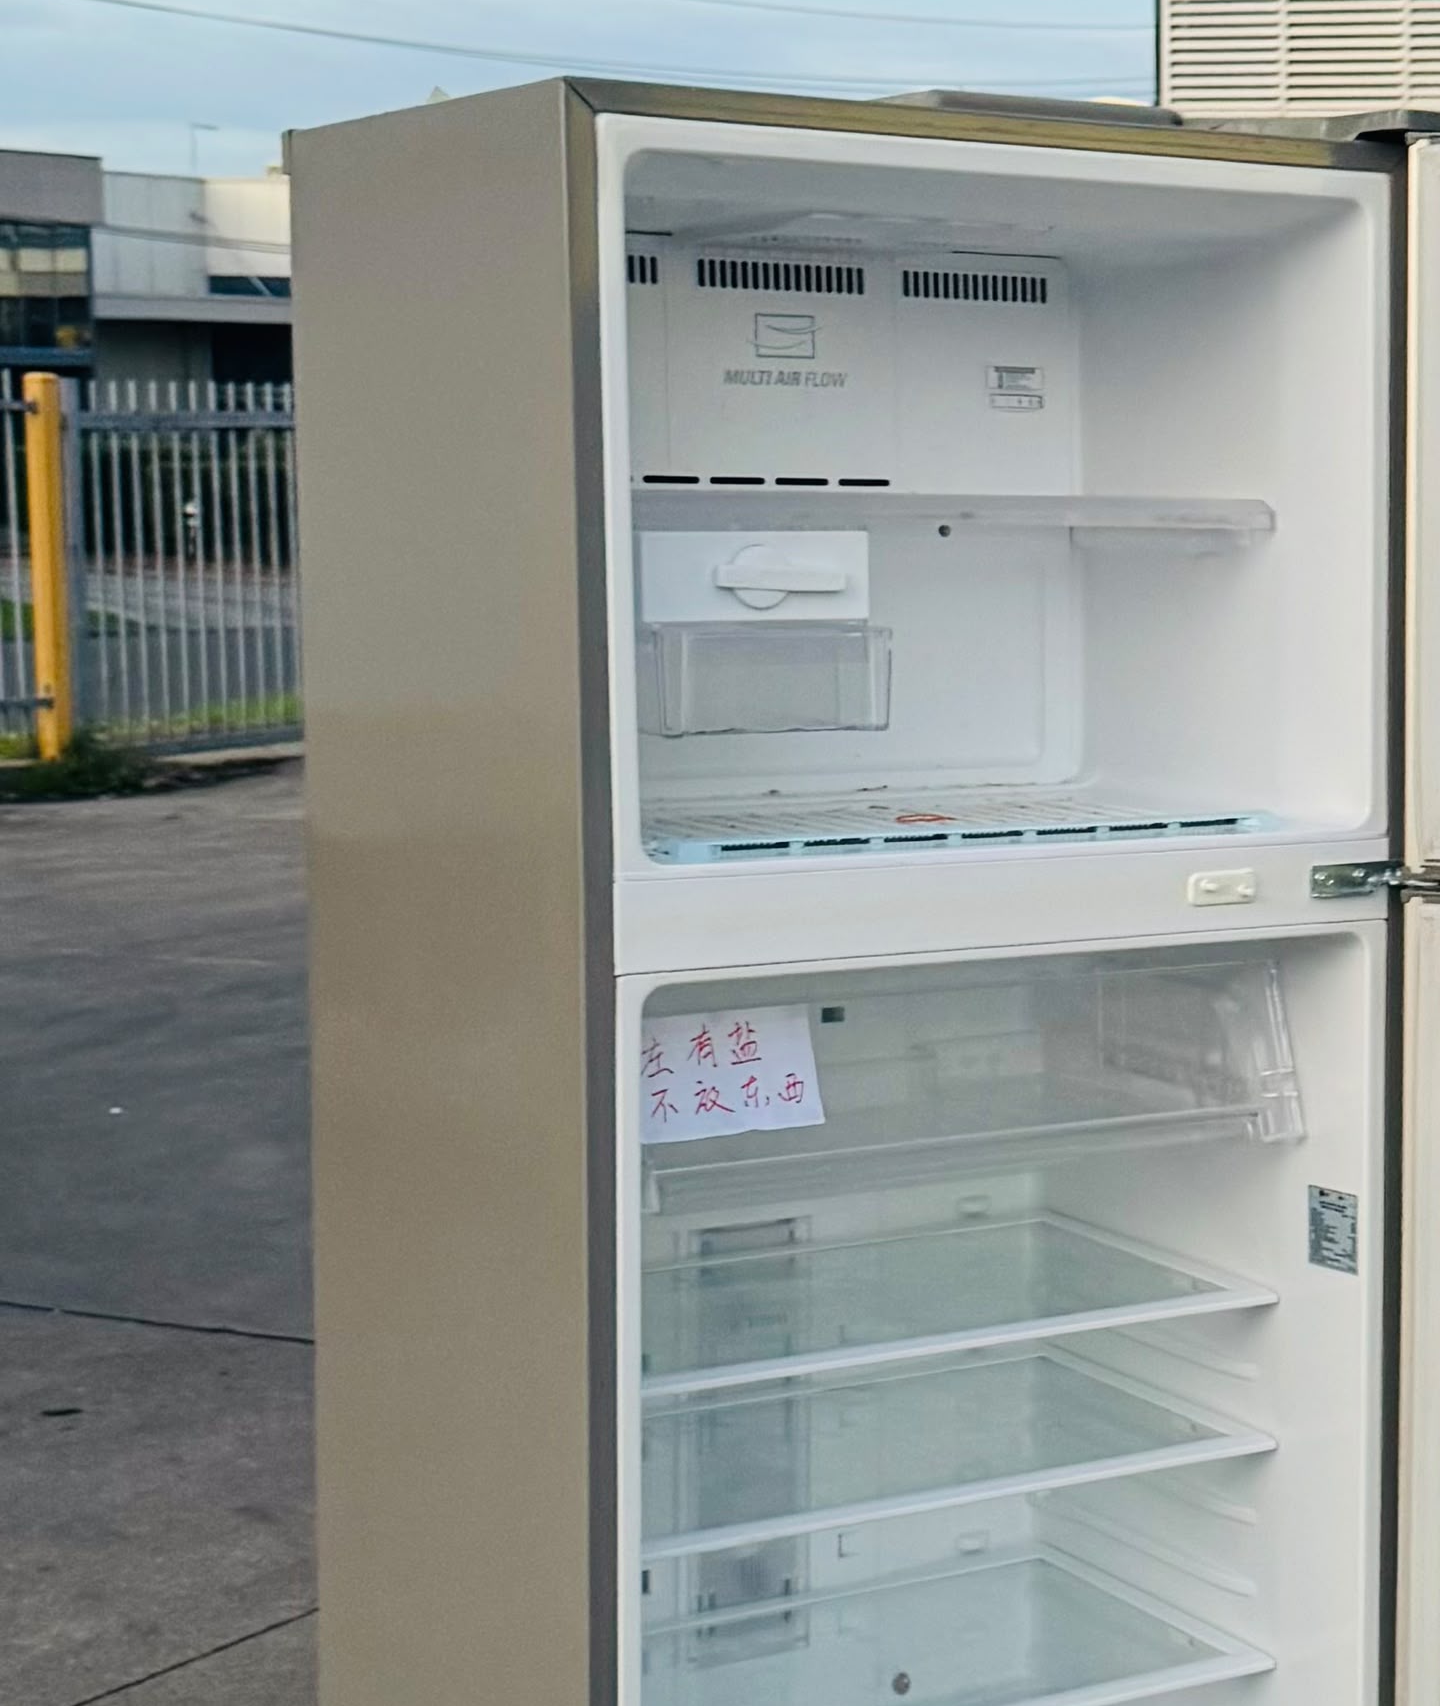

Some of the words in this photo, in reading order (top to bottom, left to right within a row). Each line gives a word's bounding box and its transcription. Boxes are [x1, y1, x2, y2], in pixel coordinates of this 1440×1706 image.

[723, 369, 772, 386] MULTI
[774, 370, 801, 386] AIR
[804, 371, 847, 387] FLOW
